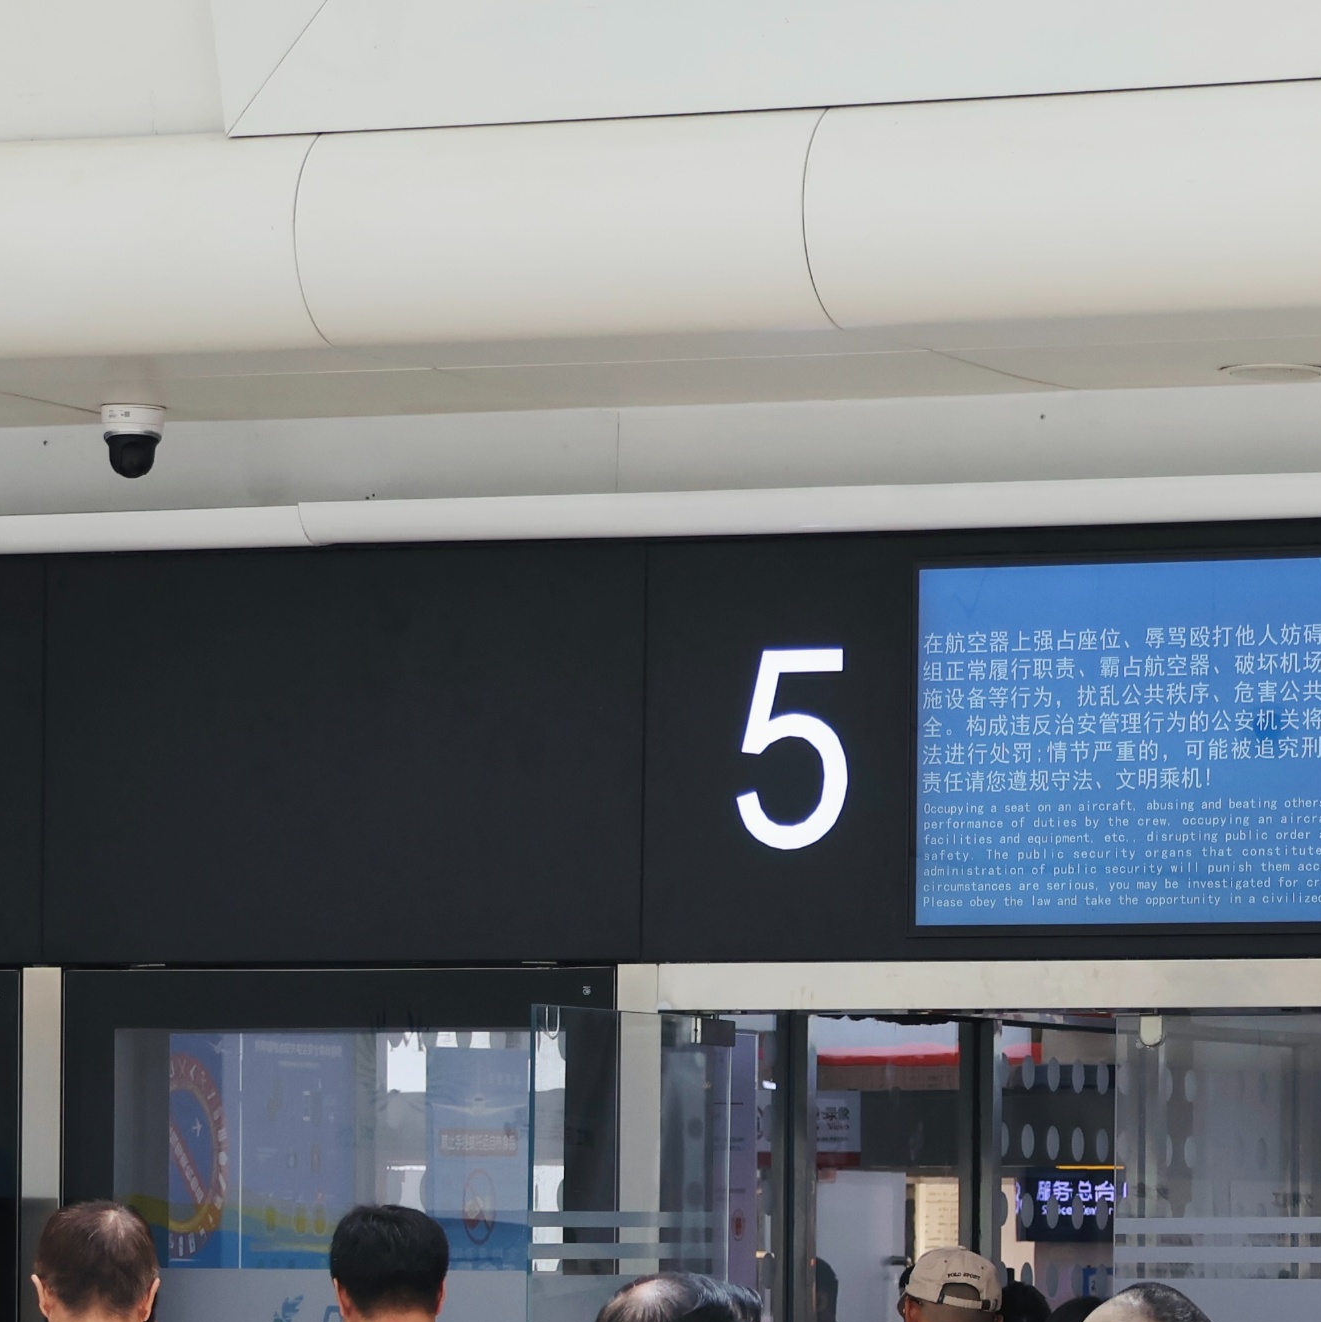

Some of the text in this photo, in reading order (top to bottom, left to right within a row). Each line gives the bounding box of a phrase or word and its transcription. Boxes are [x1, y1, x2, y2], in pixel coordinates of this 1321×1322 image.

[736, 649, 848, 850] 5
[923, 802, 985, 817] Occupying
[989, 804, 998, 814] a
[1003, 802, 1031, 813] seat
[1036, 803, 1052, 813] on
[1057, 803, 1072, 812] an
[1145, 798, 1195, 813] abusing
[1200, 797, 1223, 810] and
[1228, 797, 1278, 811] beating
[923, 817, 1004, 831] performance
[1010, 816, 1026, 829] of
[1032, 816, 1078, 828] duties
[1084, 815, 1100, 830] by
[1107, 815, 1130, 827] the
[1181, 813, 1251, 828] occupying
[1257, 815, 1273, 825] an
[923, 833, 993, 846] facilities
[998, 832, 1021, 845] and
[1146, 830, 1219, 844] disrupting
[1224, 828, 1269, 843] public
[1275, 827, 1312, 840] order
[985, 848, 1009, 861] The
[1016, 847, 1065, 862] public
[1072, 847, 1137, 861] security
[1144, 848, 1193, 860] organs
[1201, 845, 1233, 858] that
[922, 864, 1025, 877] administration
[1030, 863, 1046, 875] of
[1052, 862, 1098, 877] public
[1104, 862, 1164, 876] security
[1169, 861, 1199, 874] will
[1207, 860, 1253, 875] punish
[1259, 860, 1291, 873] them
[922, 880, 1012, 892] circumstances
[1018, 882, 1040, 892] are
[1108, 881, 1131, 892] you
[1135, 880, 1158, 892] may
[1164, 877, 1180, 890] be
[1187, 876, 1272, 891] investigated
[1277, 875, 1299, 888] for
